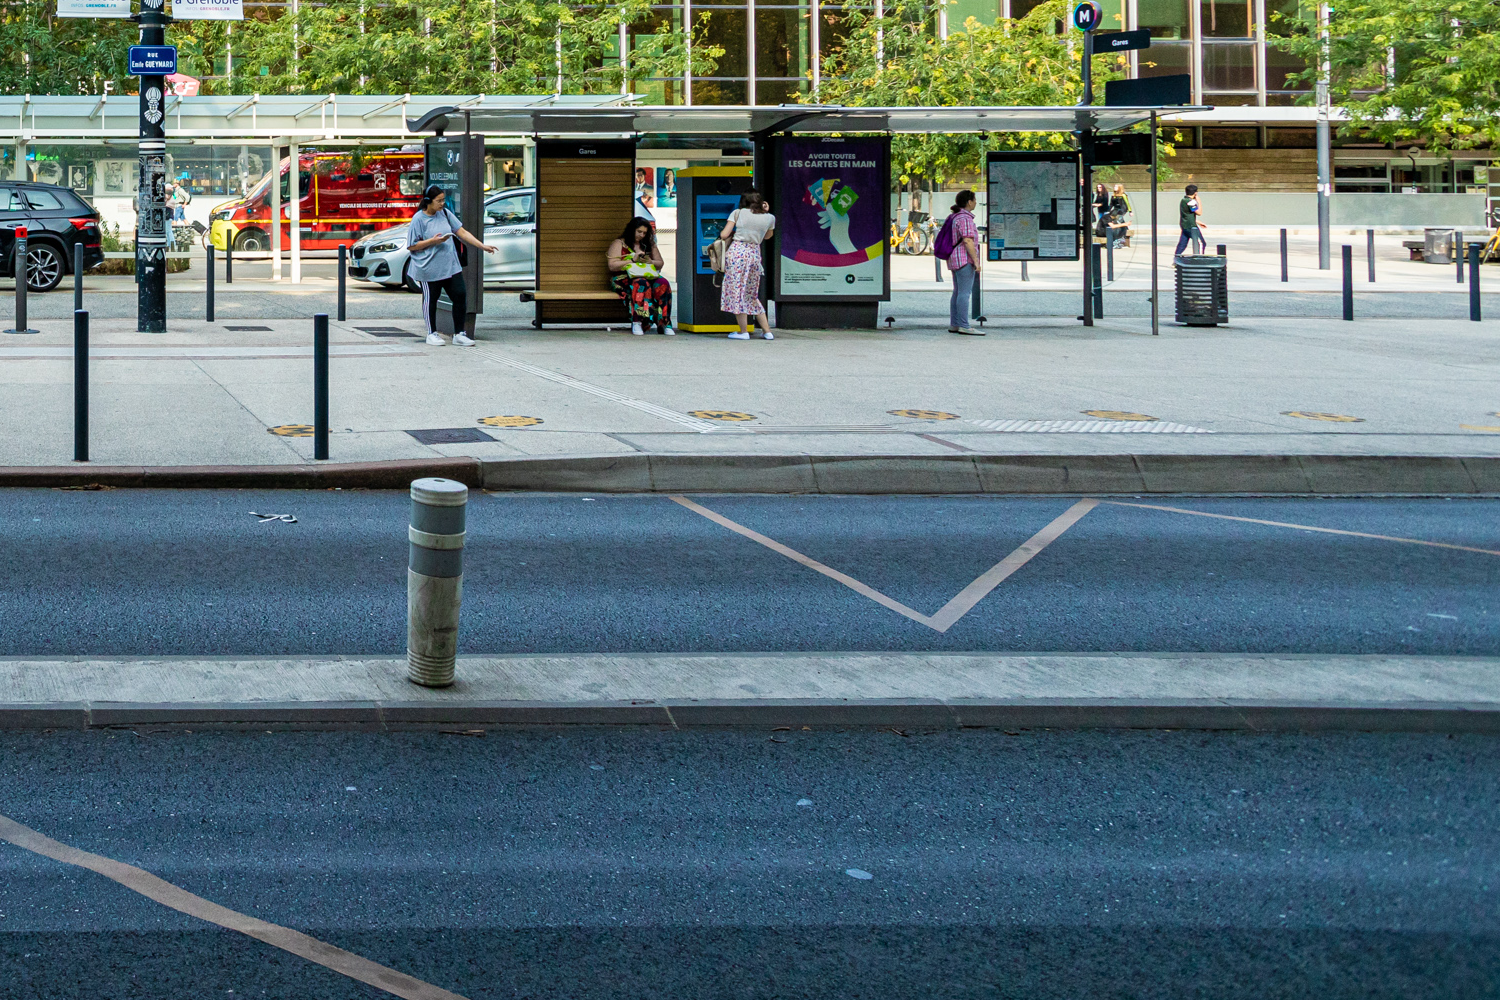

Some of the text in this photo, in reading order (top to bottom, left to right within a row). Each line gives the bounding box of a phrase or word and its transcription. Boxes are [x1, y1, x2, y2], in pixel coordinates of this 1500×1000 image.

[1079, 9, 1090, 23] M
[1111, 39, 1129, 47] Gares
[789, 160, 876, 168] LES CARTES EN MAIN
